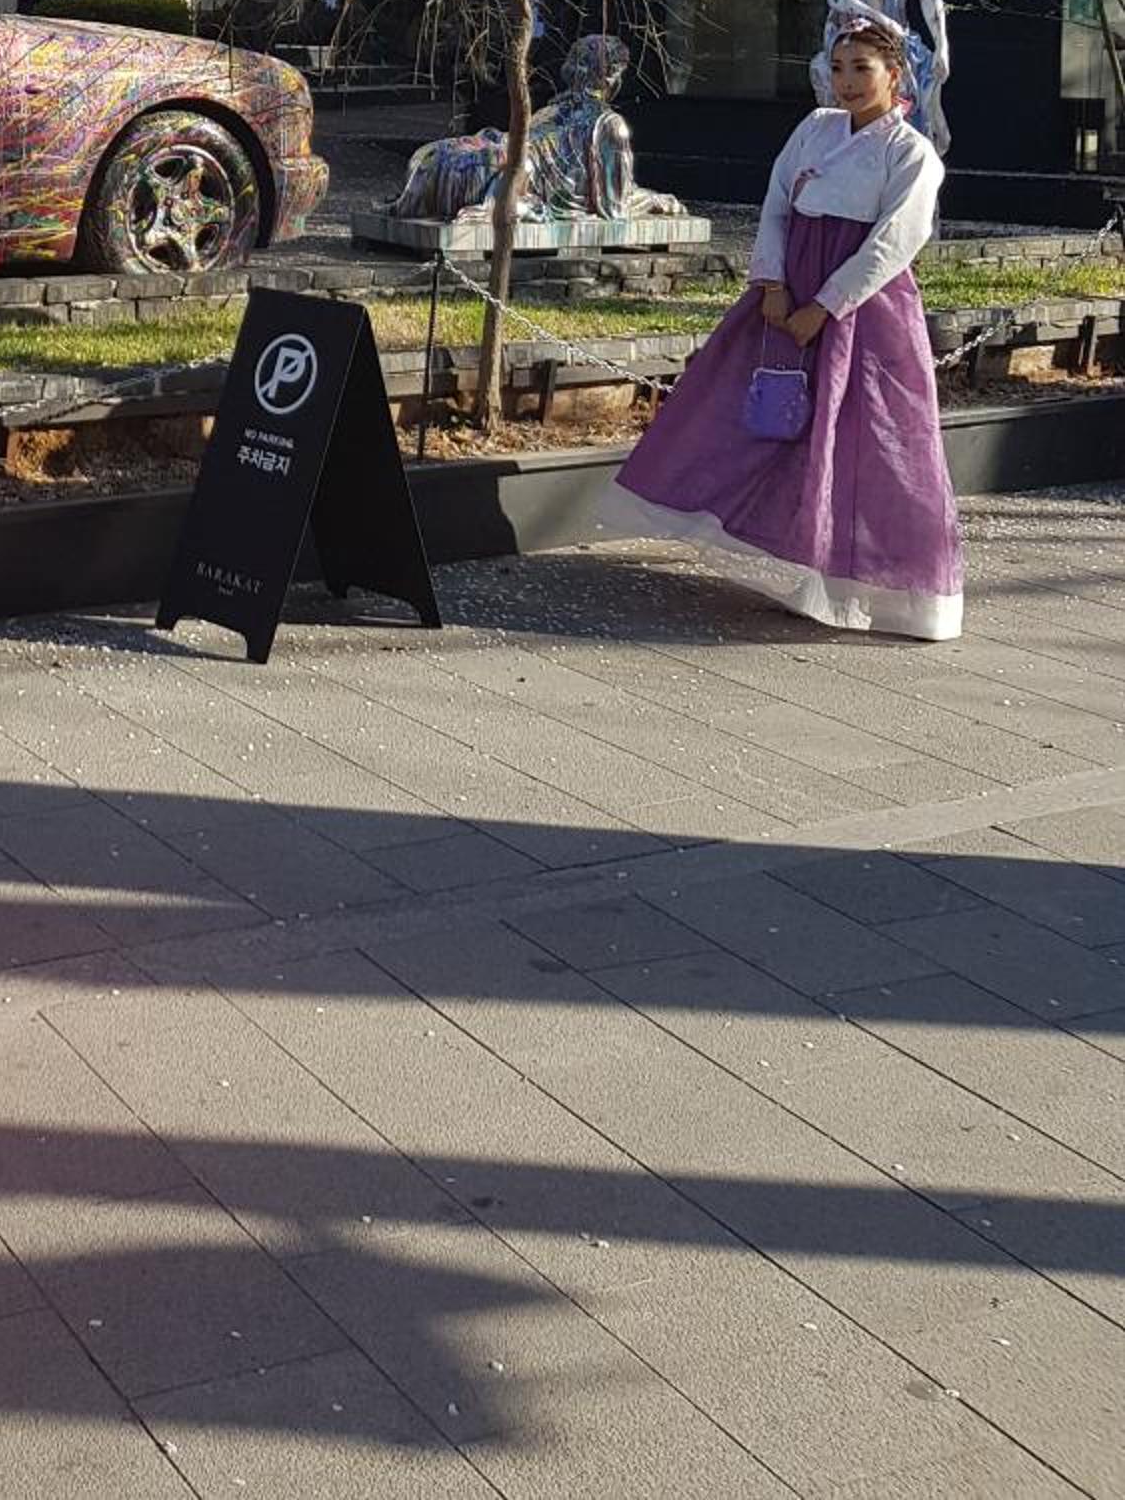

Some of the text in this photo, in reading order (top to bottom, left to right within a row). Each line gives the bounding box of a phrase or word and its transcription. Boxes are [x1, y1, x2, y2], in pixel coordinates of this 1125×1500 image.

[244, 427, 295, 449] NO PARKING
[236, 445, 291, 477] 주차금지
[195, 561, 267, 595] BARAKAT
